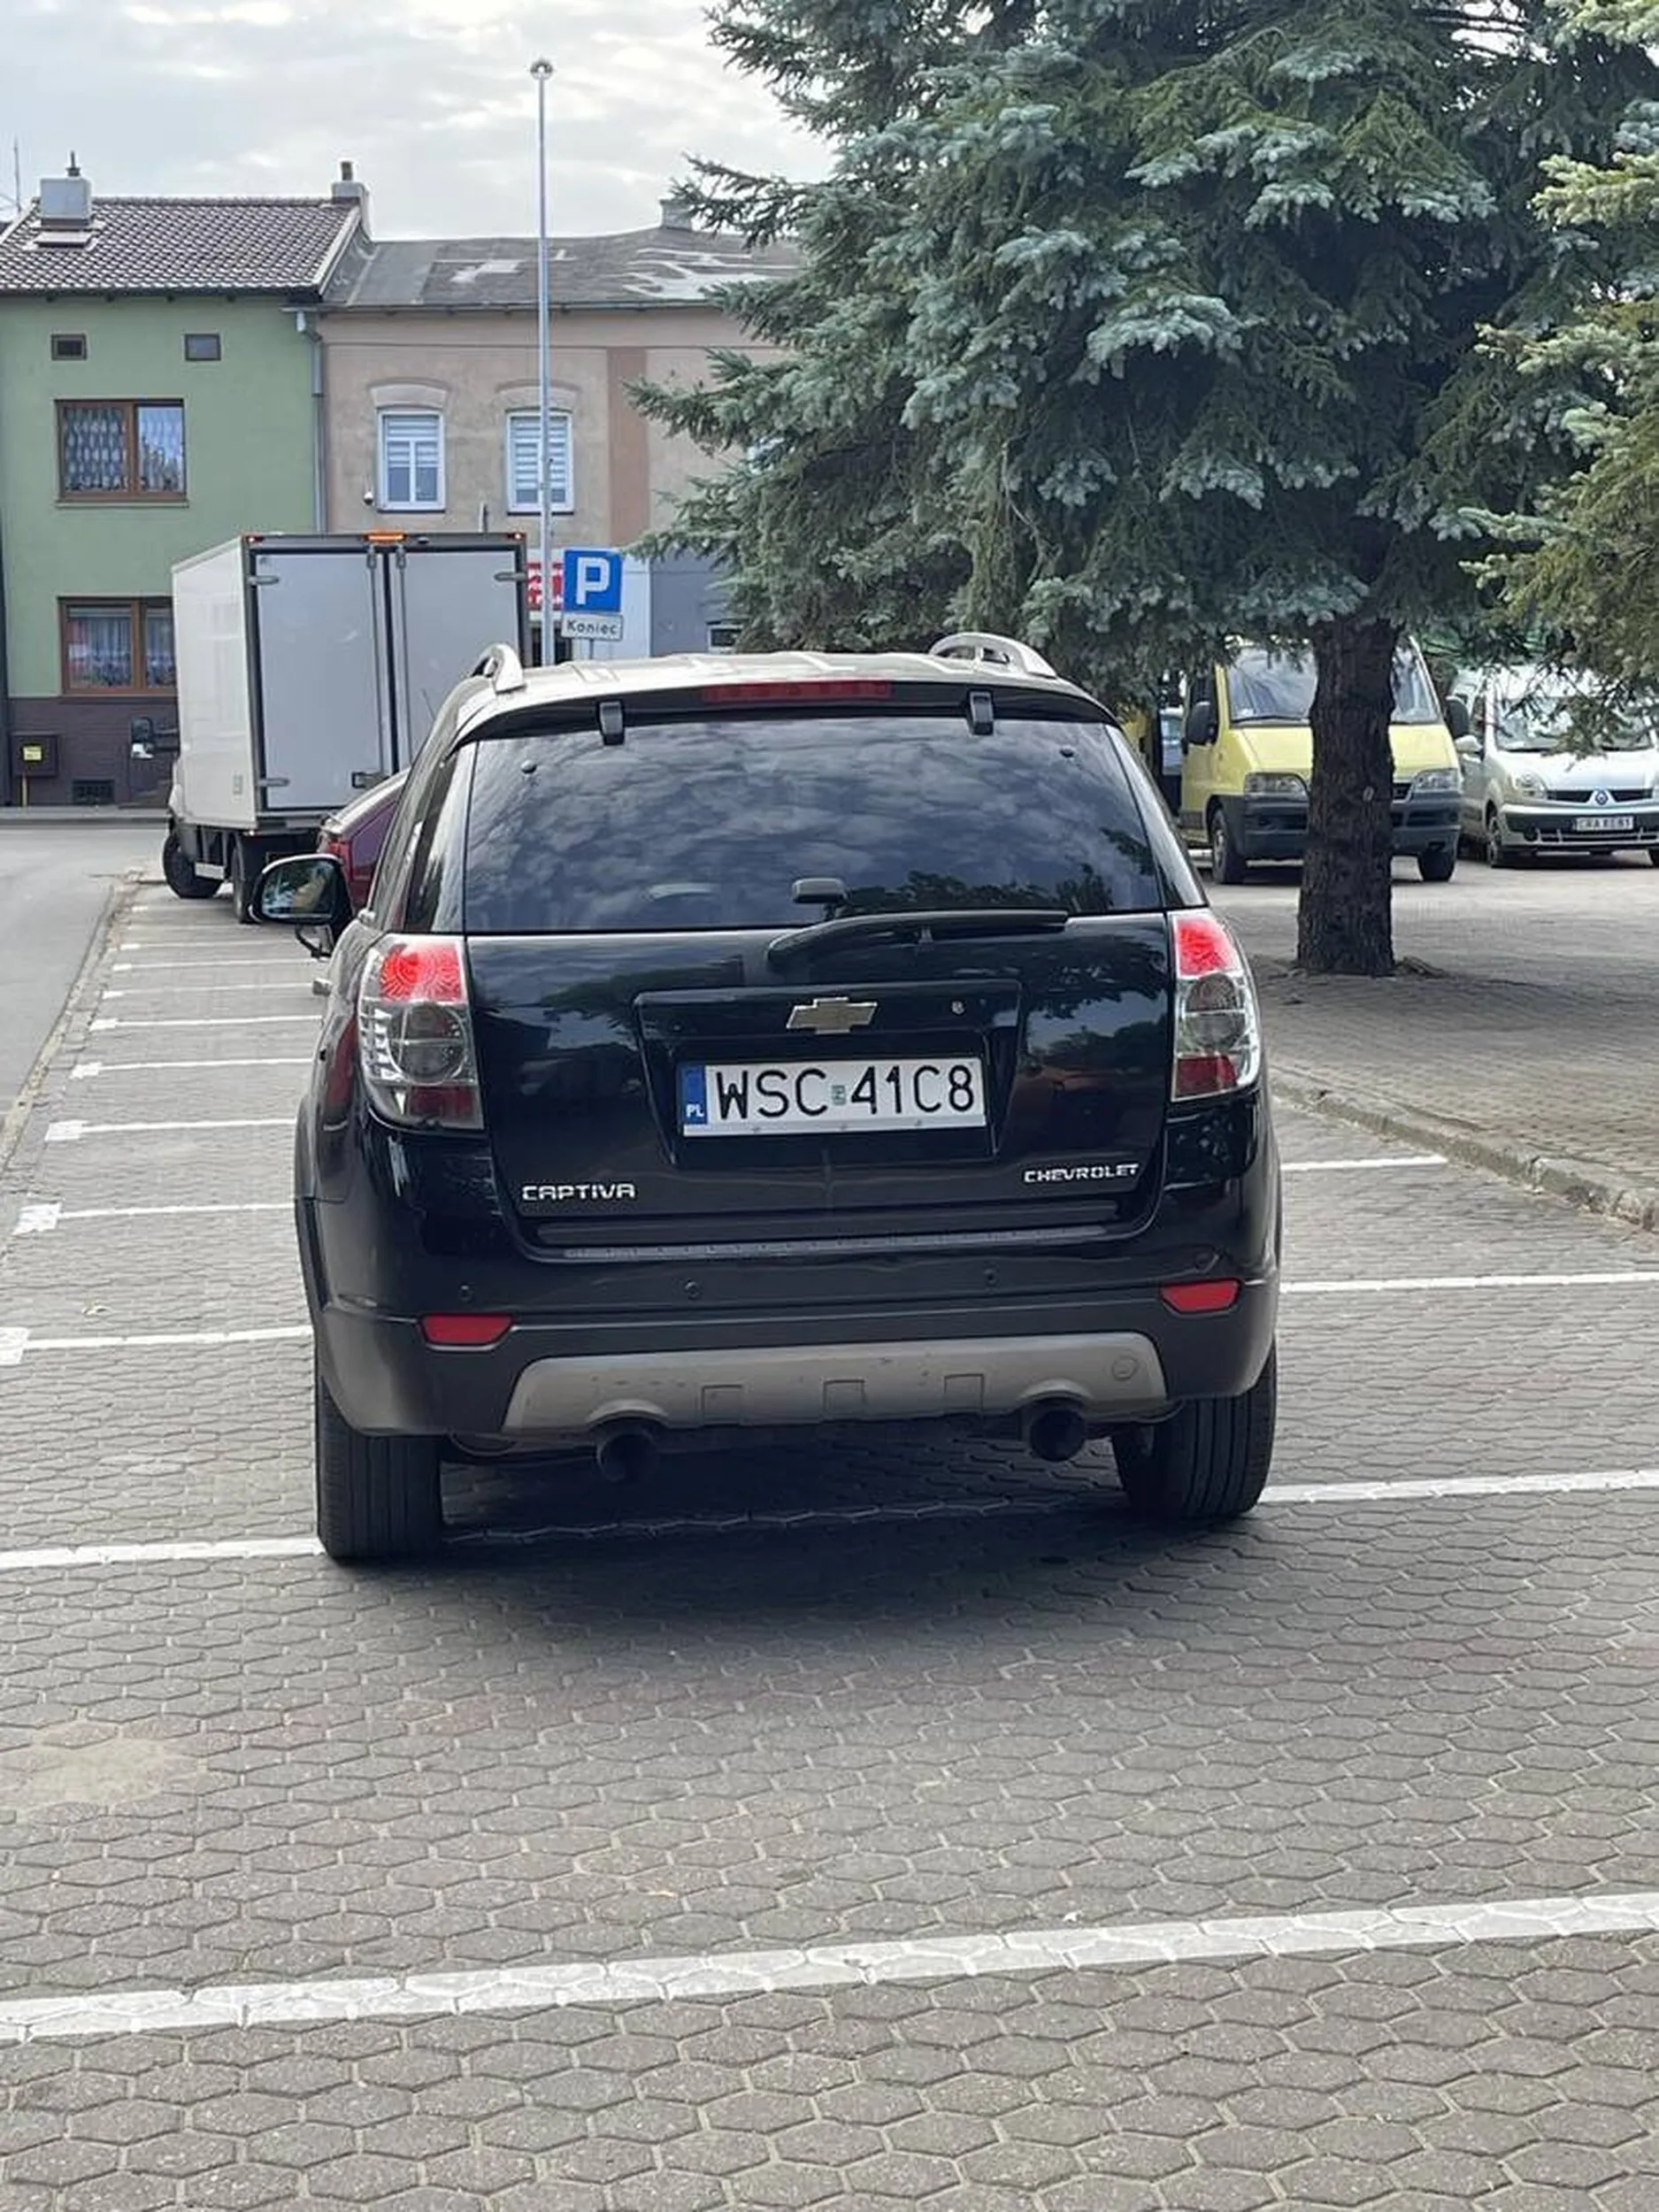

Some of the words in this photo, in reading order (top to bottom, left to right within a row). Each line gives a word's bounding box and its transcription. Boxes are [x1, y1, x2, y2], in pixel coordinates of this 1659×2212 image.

[576, 557, 611, 605] P
[567, 620, 617, 634] Koniec
[716, 1068, 828, 1119] WSC
[850, 1064, 975, 1115] 41C8
[686, 1103, 704, 1118] PL
[1024, 1163, 1139, 1183] CHEVROLET
[522, 1183, 636, 1201] CAPTIVA
